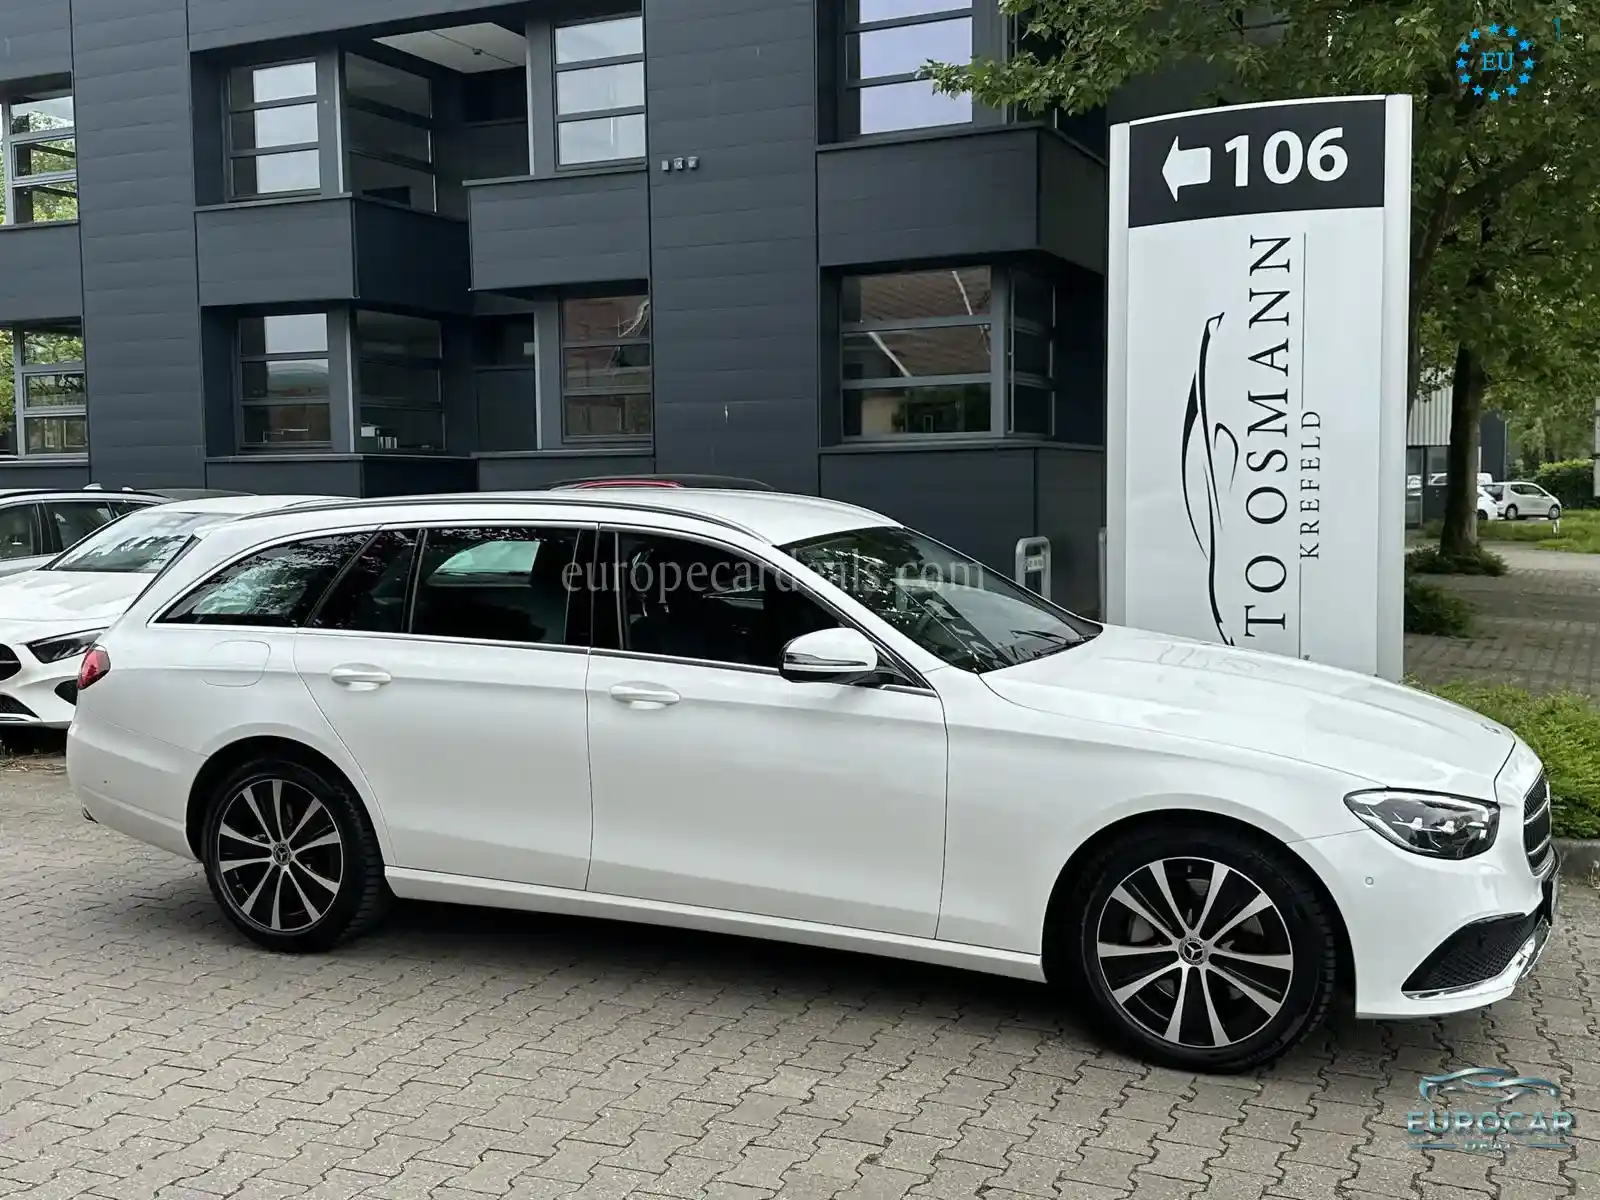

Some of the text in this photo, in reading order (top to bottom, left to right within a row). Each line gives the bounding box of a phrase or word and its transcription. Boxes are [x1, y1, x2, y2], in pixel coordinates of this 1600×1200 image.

[1224, 127, 1349, 187] 106
[1244, 234, 1292, 638] TO OSMANN
[1299, 411, 1322, 560] KREFELD
